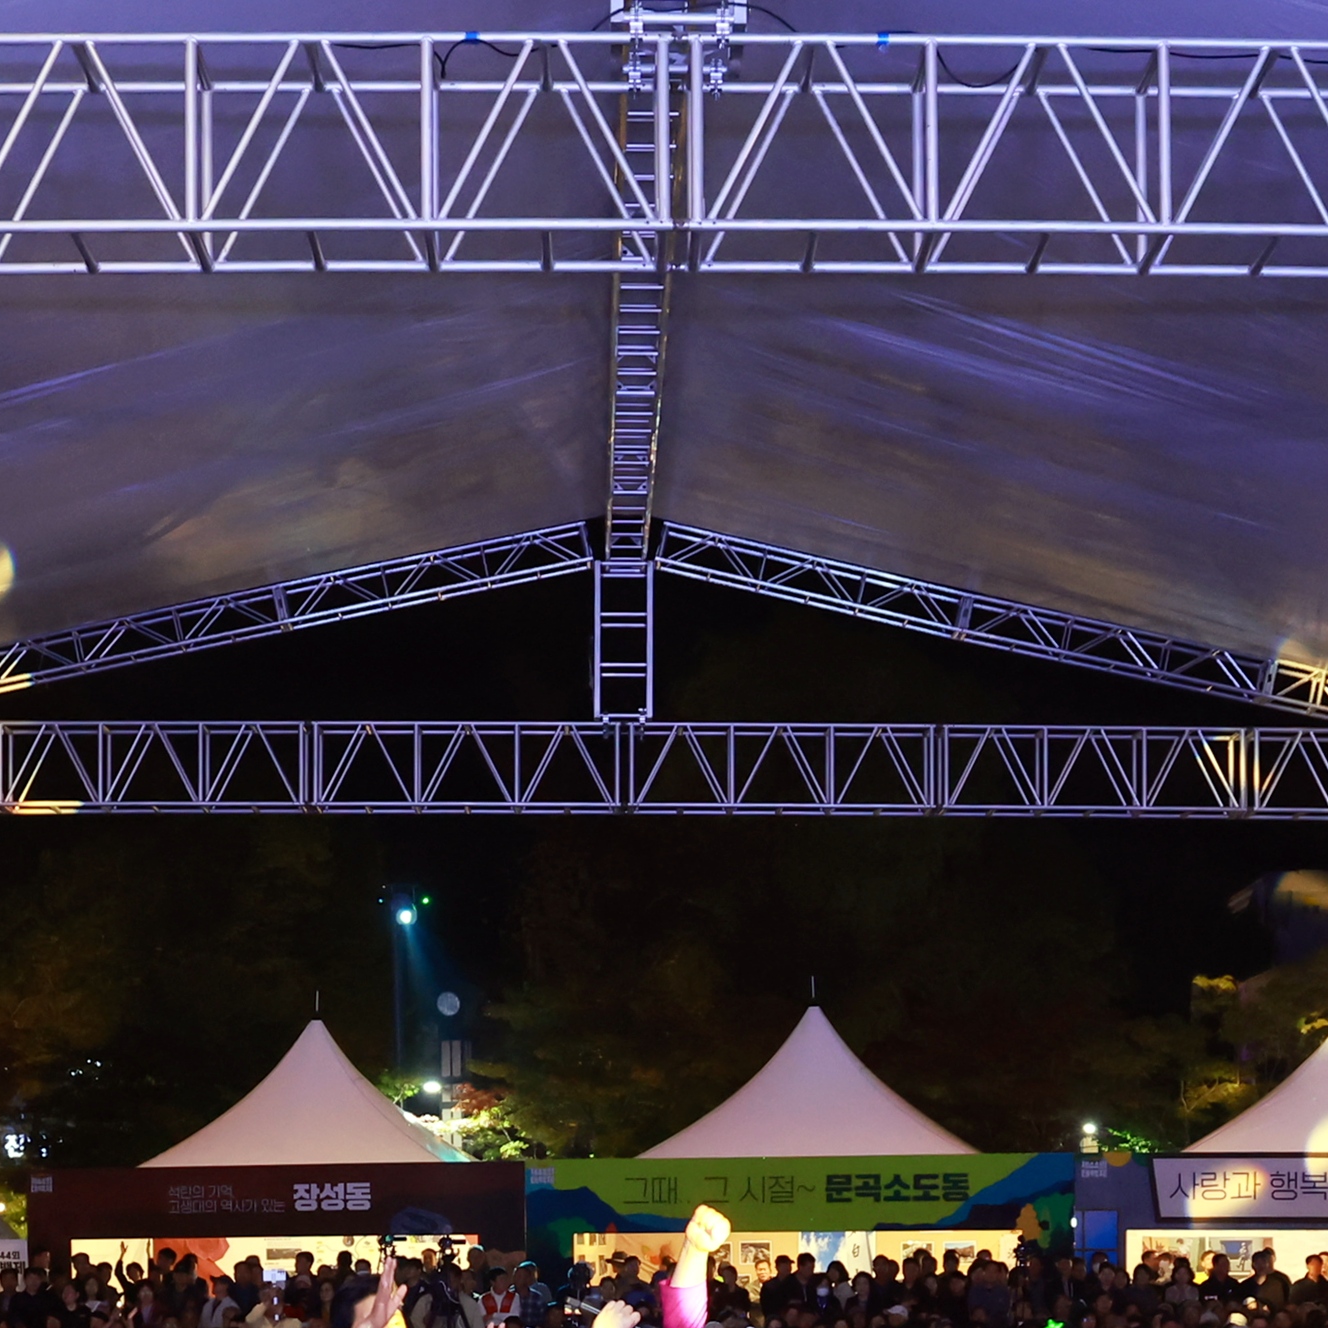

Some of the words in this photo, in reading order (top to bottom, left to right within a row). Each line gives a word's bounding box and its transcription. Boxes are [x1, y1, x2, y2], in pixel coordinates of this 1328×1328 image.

[292, 1182, 372, 1212] 장성동
[704, 1176, 729, 1203] 그
[825, 1173, 970, 1202] 문곡소도동
[1170, 1171, 1261, 1200] 사랑과
[169, 1199, 217, 1213] 고생대의
[220, 1199, 258, 1213] 역사가
[261, 1198, 287, 1213] 있는
